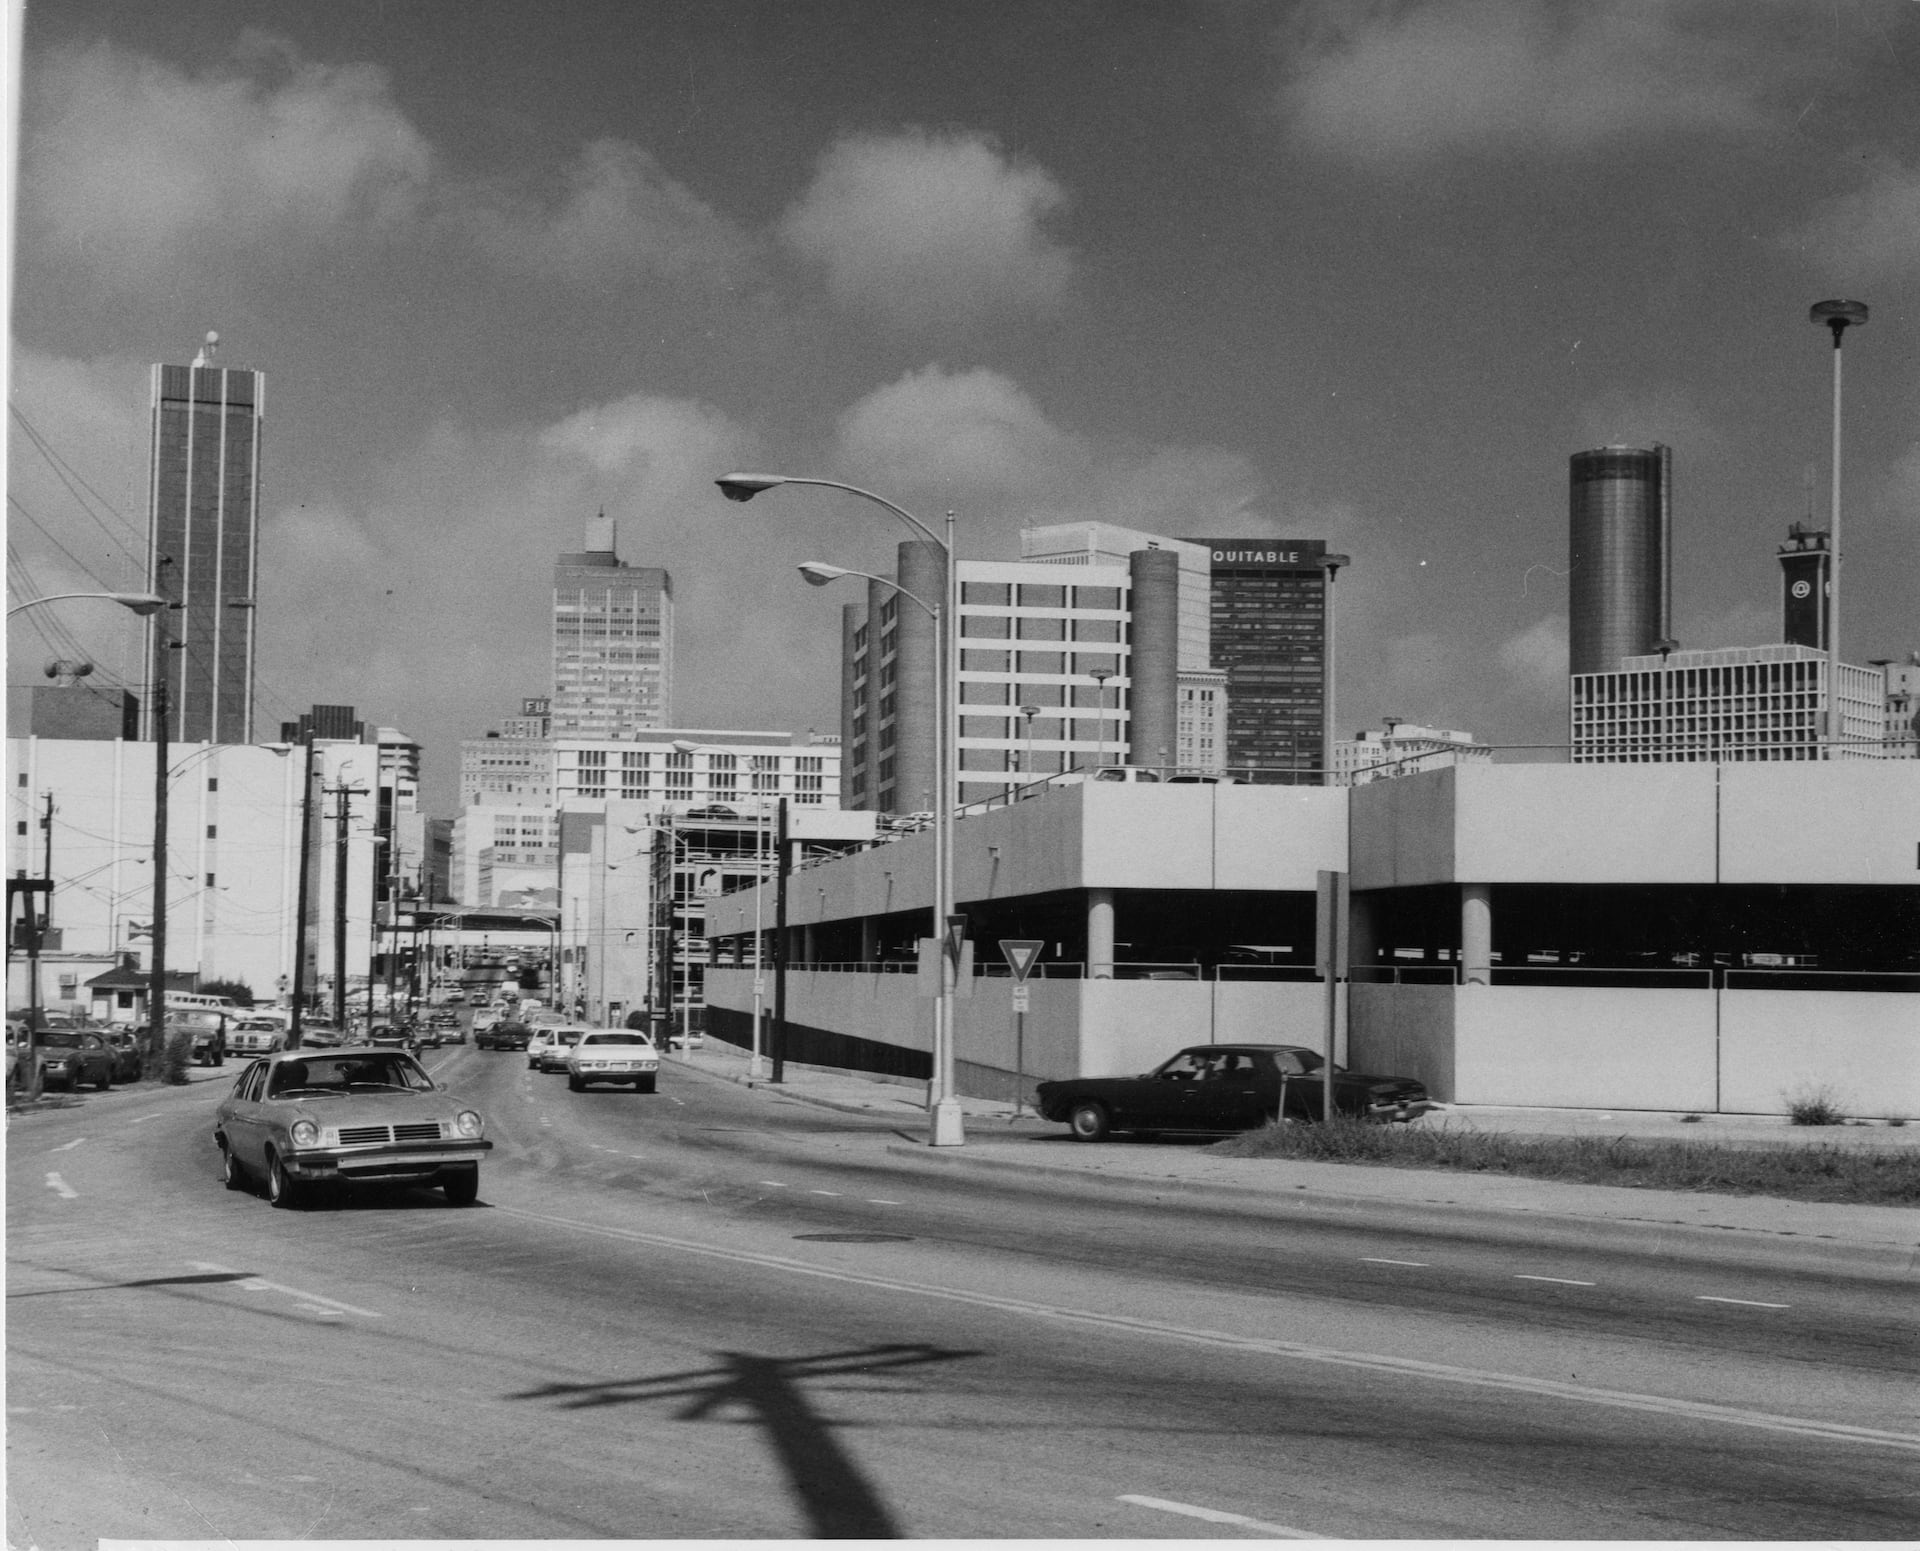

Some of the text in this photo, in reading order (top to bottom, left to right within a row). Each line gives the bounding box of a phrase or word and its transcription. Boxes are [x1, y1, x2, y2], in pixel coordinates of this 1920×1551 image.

[1212, 550, 1299, 563] QUITABLE
[526, 701, 545, 713] FU
[696, 887, 719, 895] ONLY
